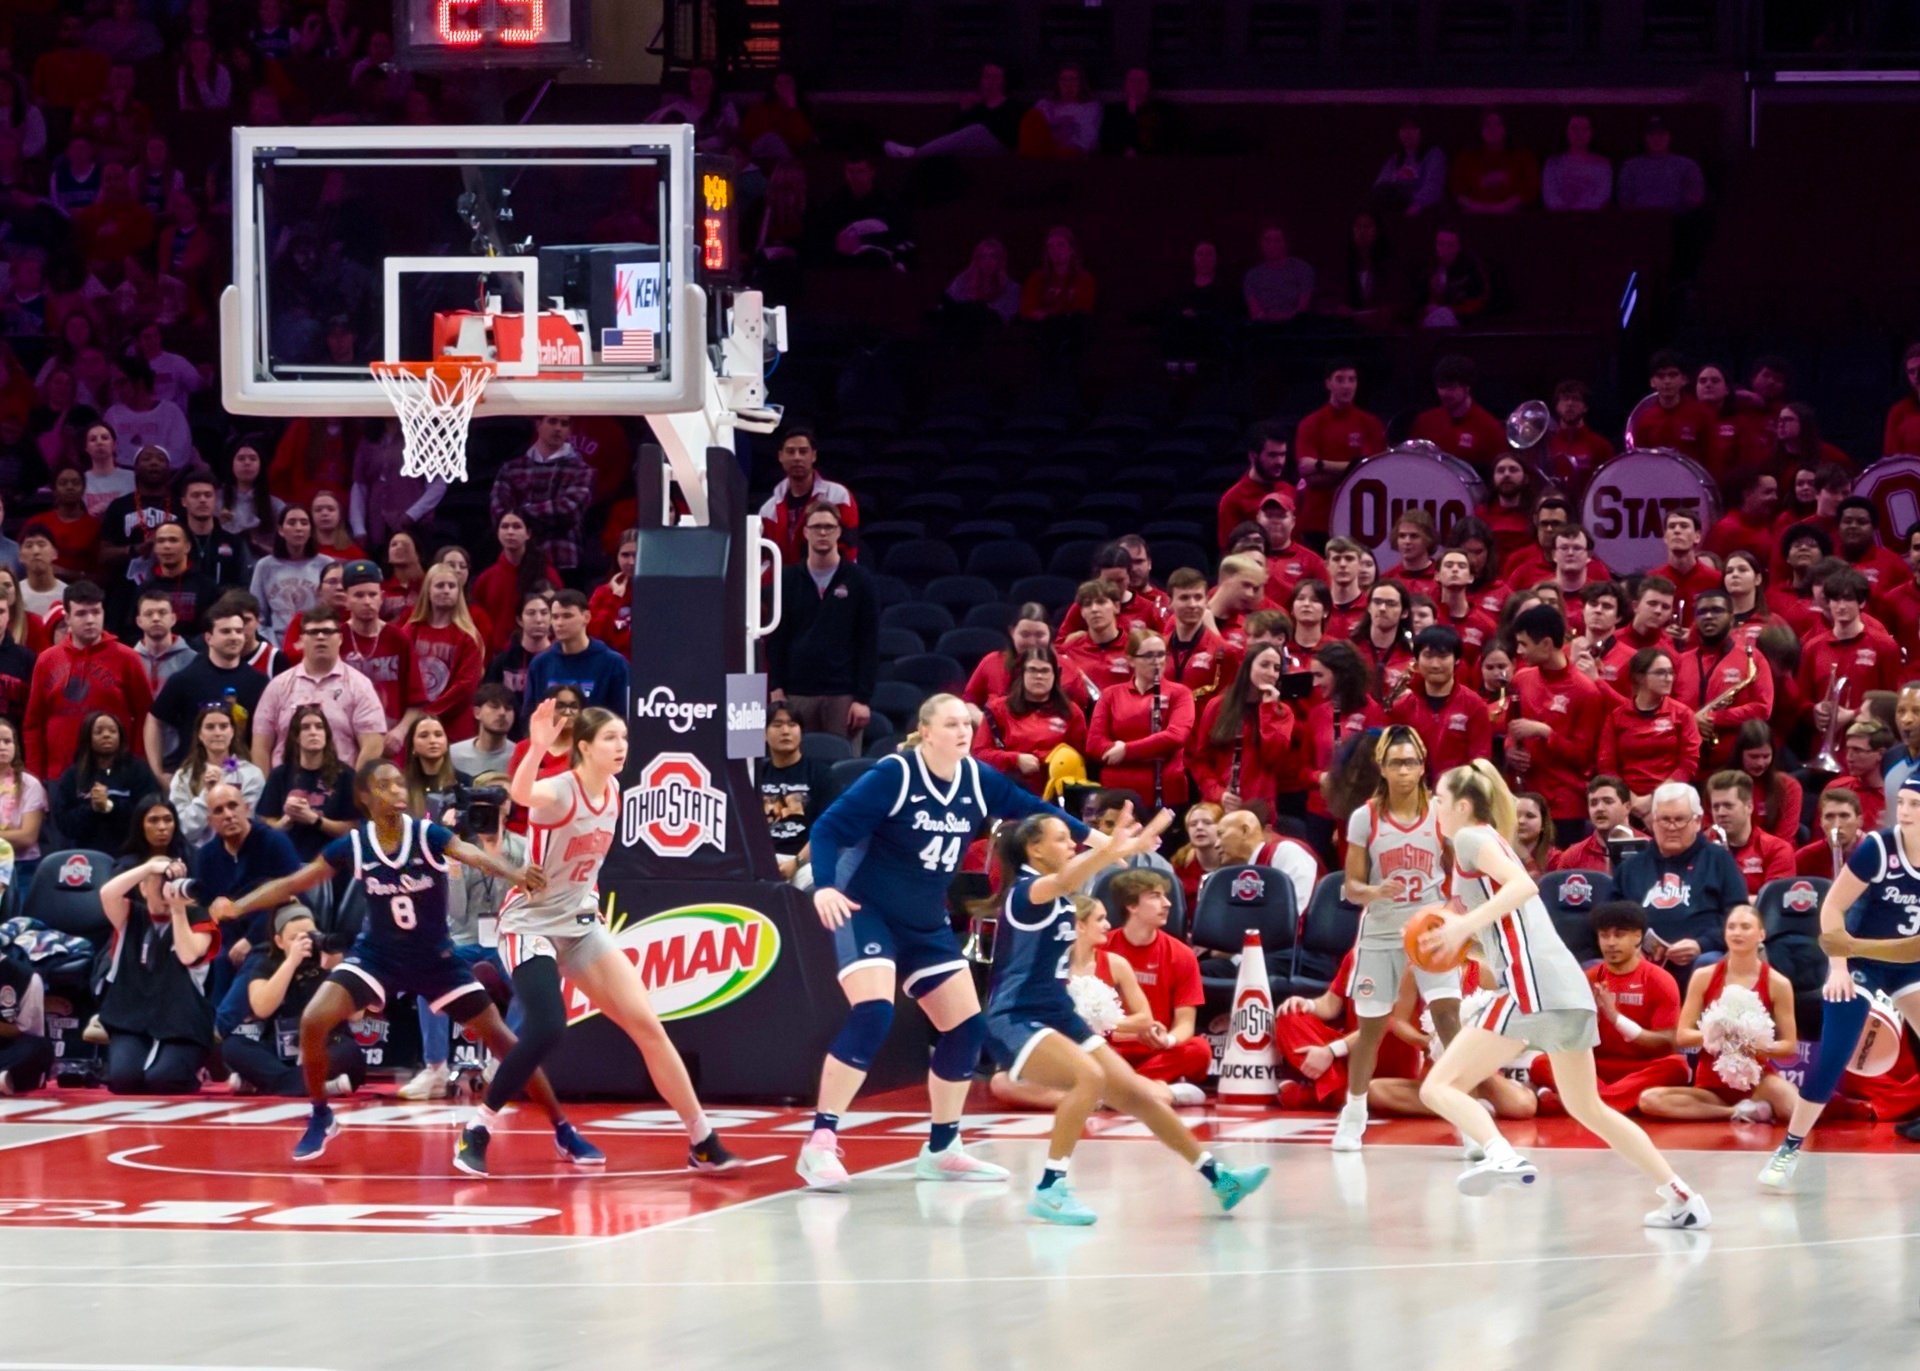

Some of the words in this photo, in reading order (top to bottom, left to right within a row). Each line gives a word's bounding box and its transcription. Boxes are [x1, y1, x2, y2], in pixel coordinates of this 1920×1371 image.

[638, 685, 718, 734] Kroger
[727, 700, 766, 731] Safelite
[626, 788, 667, 843] OHIO
[668, 782, 724, 847] STATE
[913, 810, 945, 832] Penn
[945, 812, 972, 833] State
[919, 836, 962, 872] 44
[569, 859, 595, 882] 12
[1881, 885, 1918, 905] Penn
[391, 895, 417, 931] 8
[361, 1047, 384, 1065] 13
